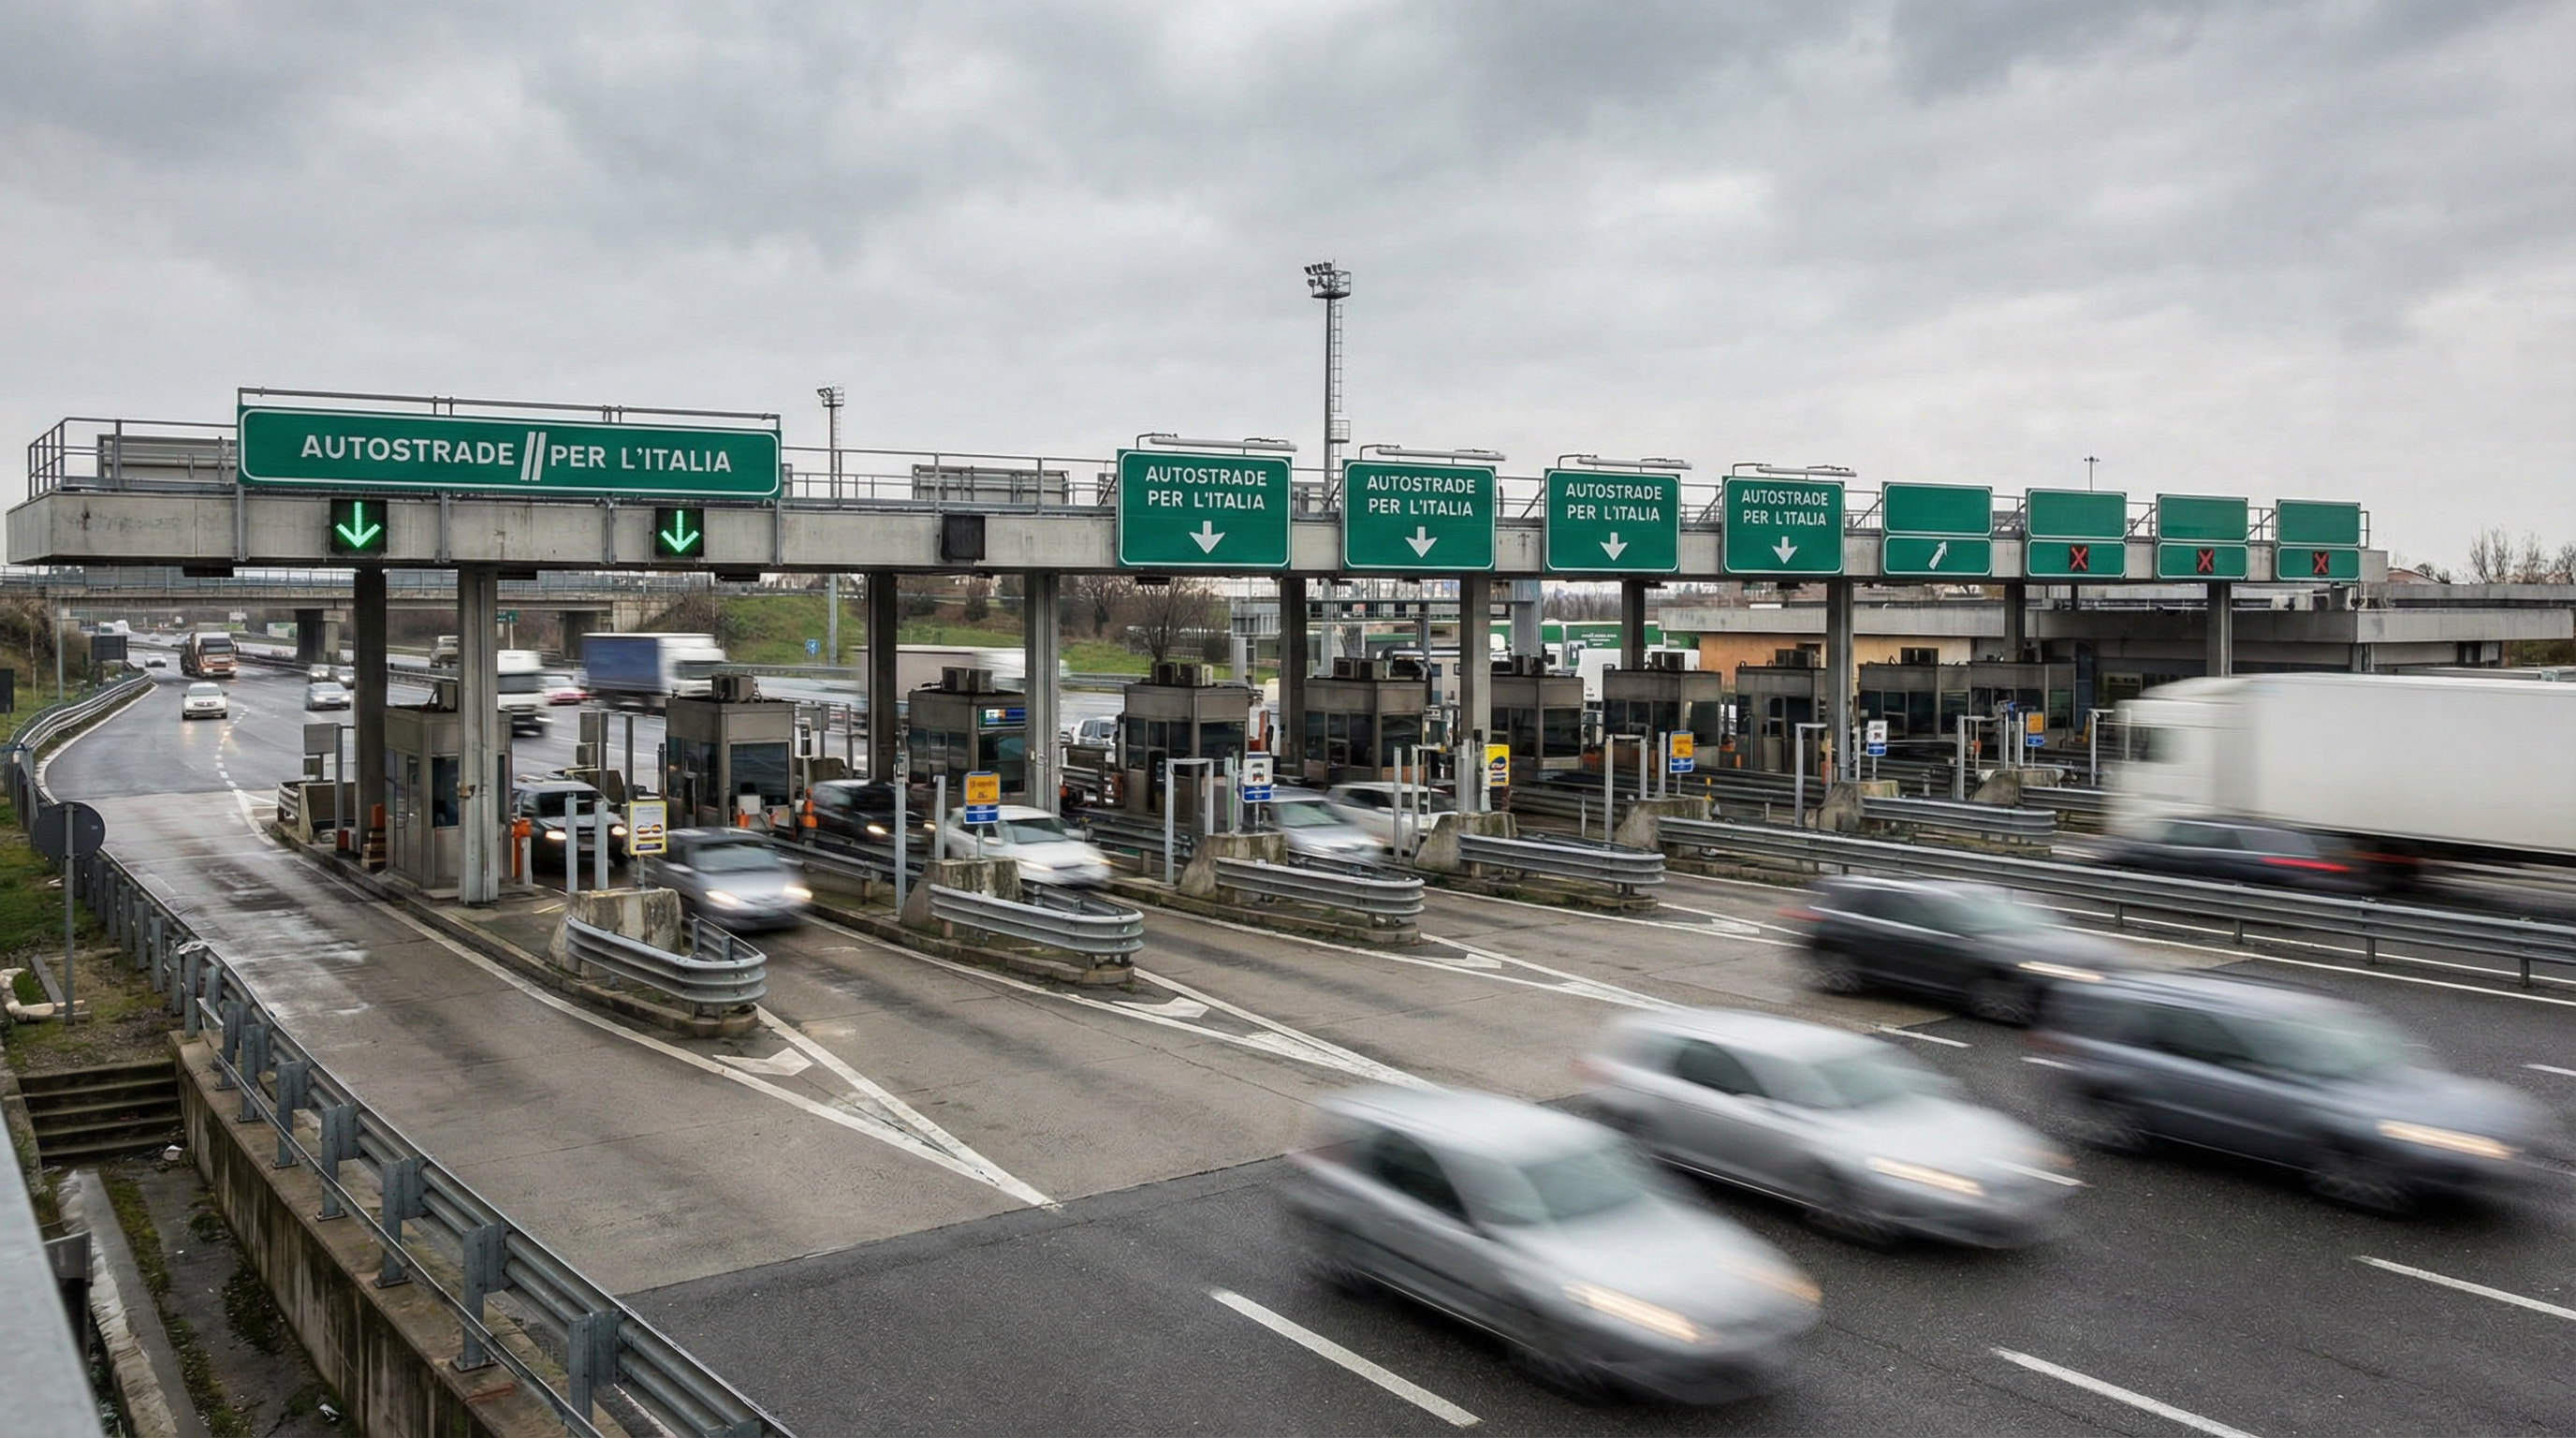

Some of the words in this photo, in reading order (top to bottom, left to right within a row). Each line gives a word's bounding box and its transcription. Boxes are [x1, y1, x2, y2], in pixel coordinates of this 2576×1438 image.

[300, 434, 515, 465] AUTOSTRADE
[550, 445, 606, 468] PER
[622, 448, 731, 473] L'ITALIA
[1145, 465, 1267, 487] AUTOSTRADE
[1367, 475, 1475, 494] AUTOSTRADE
[1148, 490, 1183, 507] PER
[1193, 492, 1265, 510] L'ITALIA
[1565, 482, 1662, 500] AUTOSTRADE
[1741, 489, 1829, 506] AUTOSTRADE
[1368, 498, 1400, 514] PER
[1410, 499, 1473, 517] L'ITALIA
[1567, 504, 1596, 520] PER
[1603, 506, 1661, 521] L'ITALIA
[1743, 509, 1769, 524] PER
